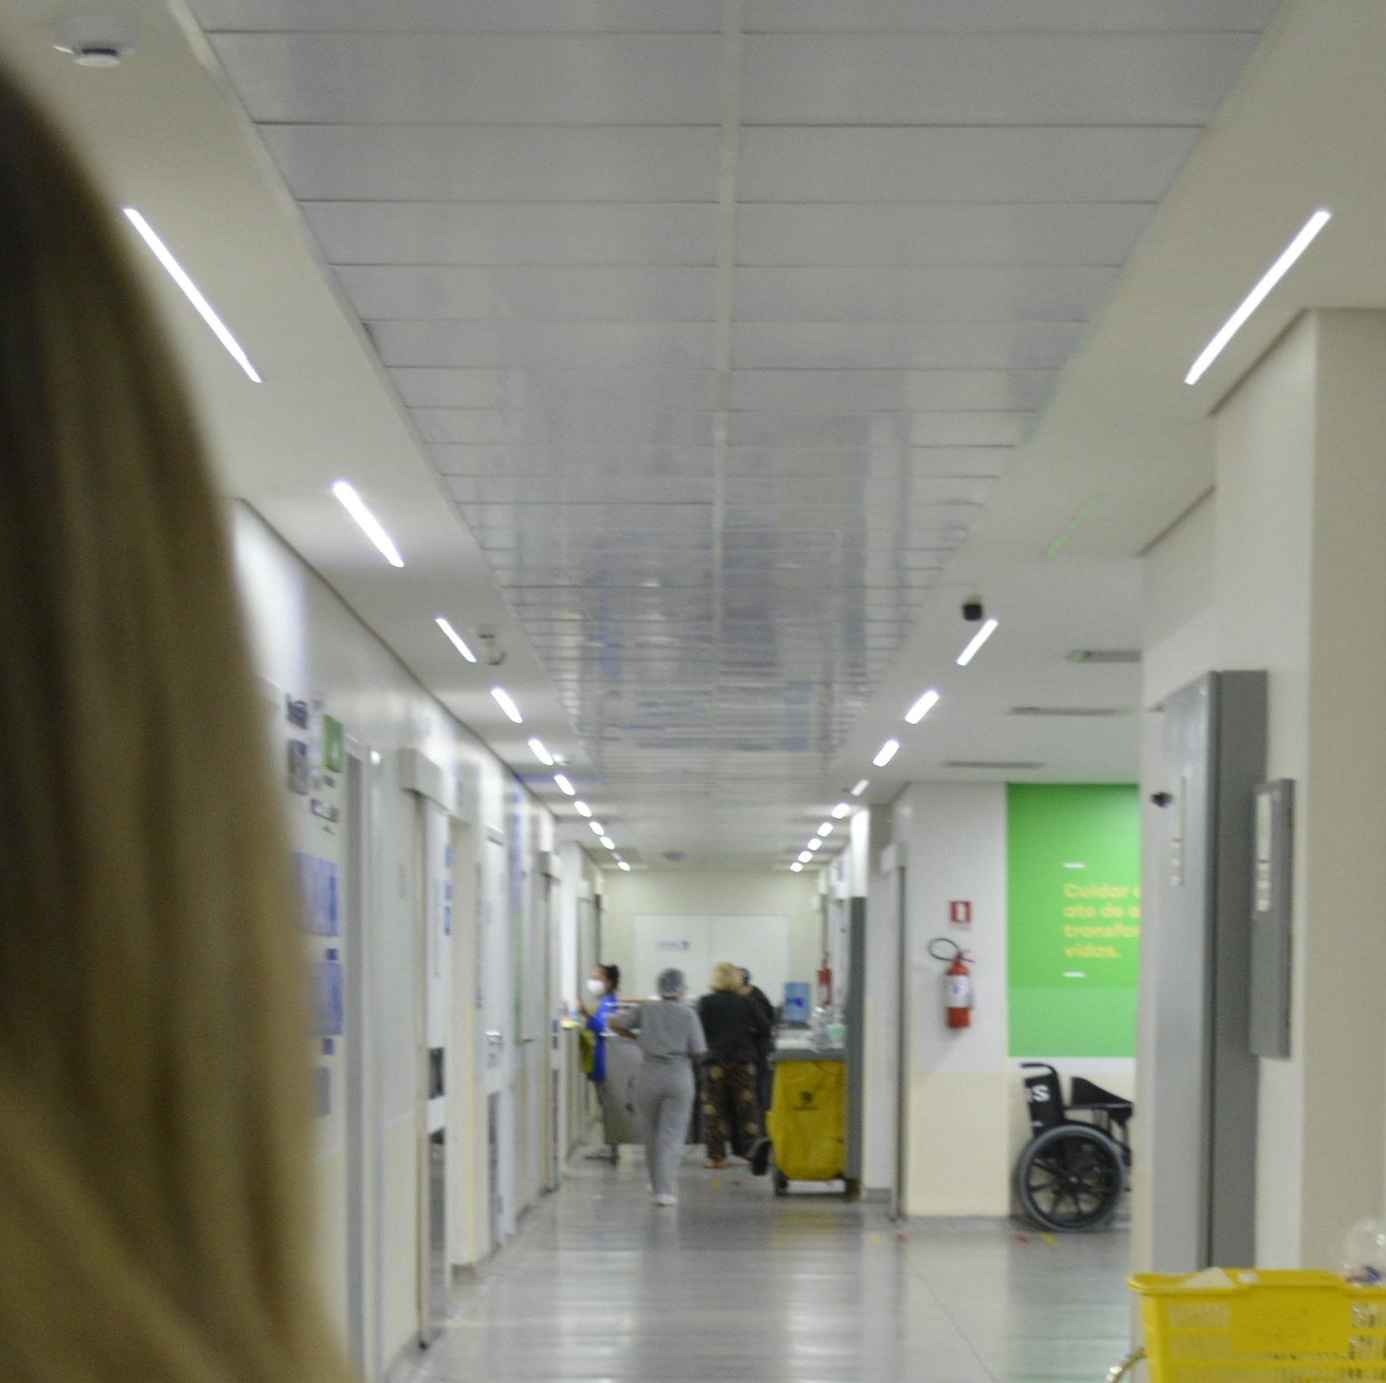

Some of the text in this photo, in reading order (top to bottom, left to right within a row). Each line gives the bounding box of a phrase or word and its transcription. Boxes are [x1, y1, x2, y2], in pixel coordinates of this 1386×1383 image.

[1064, 883, 1129, 899] Cuidar
[1101, 903, 1125, 918] de
[1064, 923, 1141, 938] transfor
